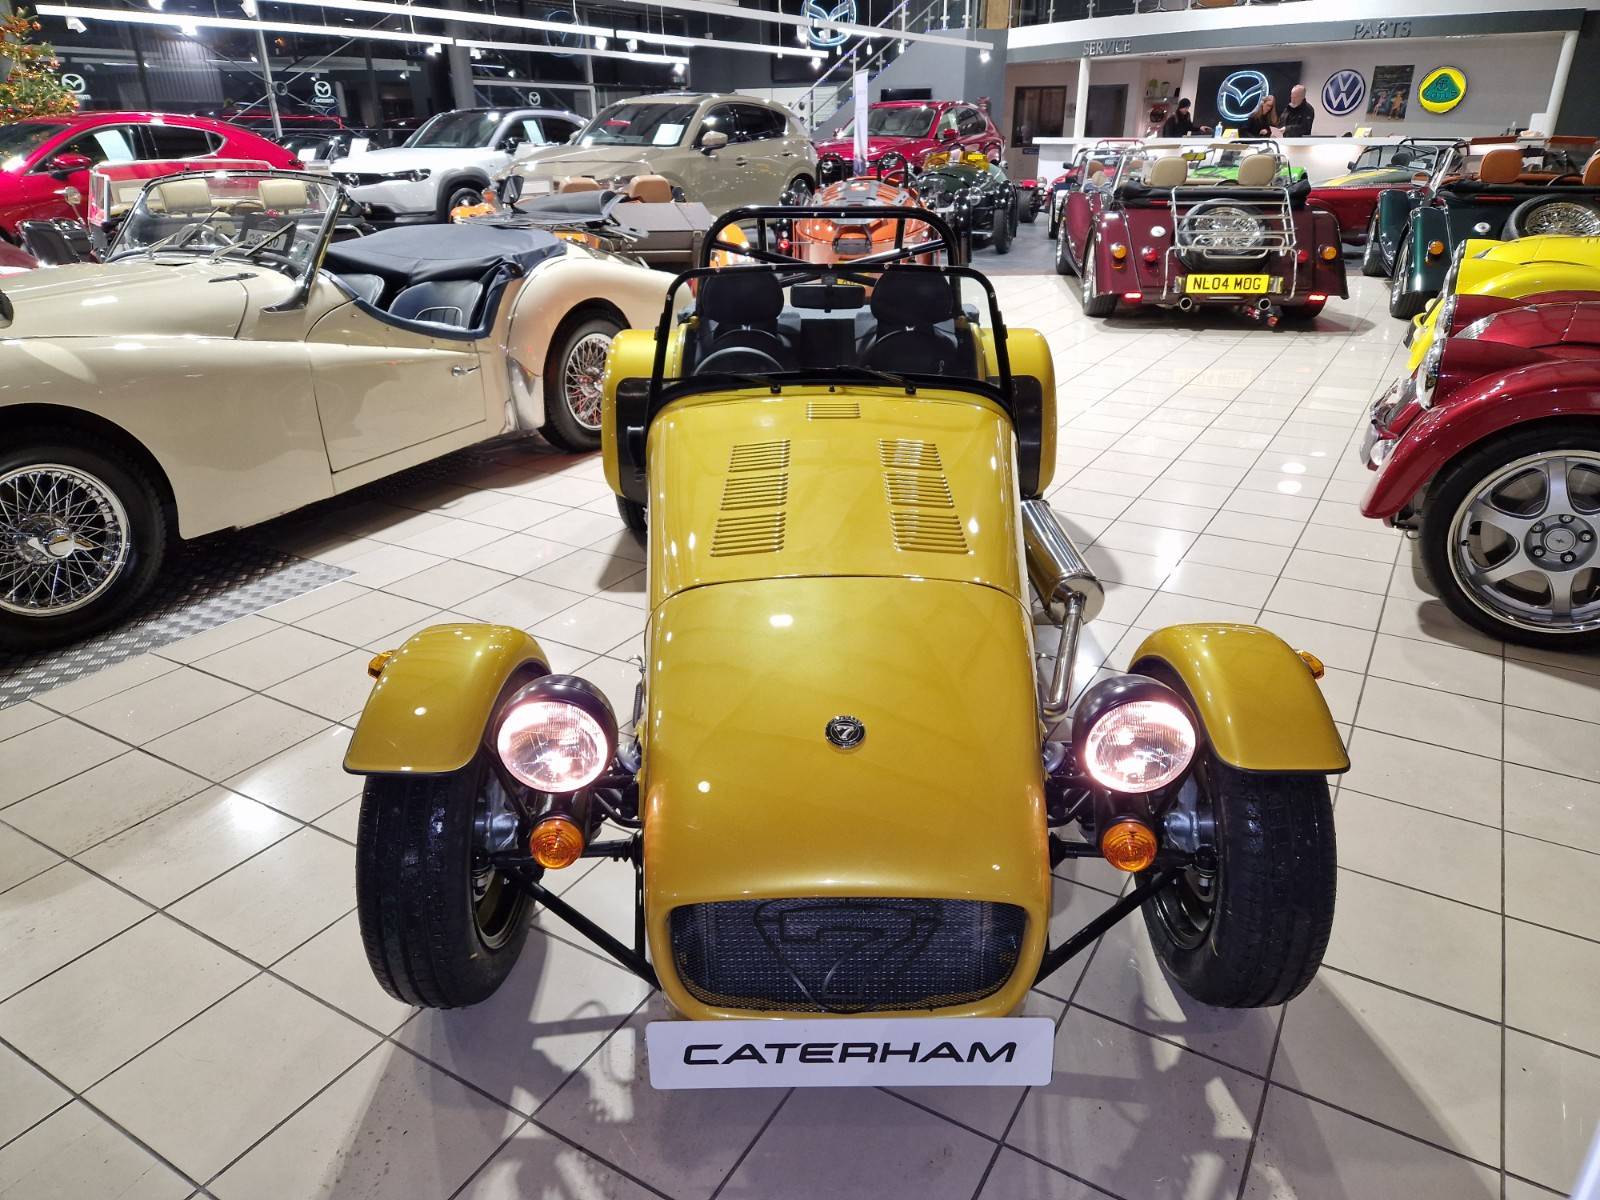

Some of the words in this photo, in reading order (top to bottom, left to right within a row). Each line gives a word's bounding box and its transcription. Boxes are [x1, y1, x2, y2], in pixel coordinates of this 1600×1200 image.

[1353, 21, 1412, 39] PARTS
[1083, 40, 1131, 56] SERVICE
[1193, 277, 1230, 291] NL04
[1233, 277, 1262, 291] MOG
[835, 725, 855, 741] 7
[683, 1041, 1018, 1066] CATERHAM
